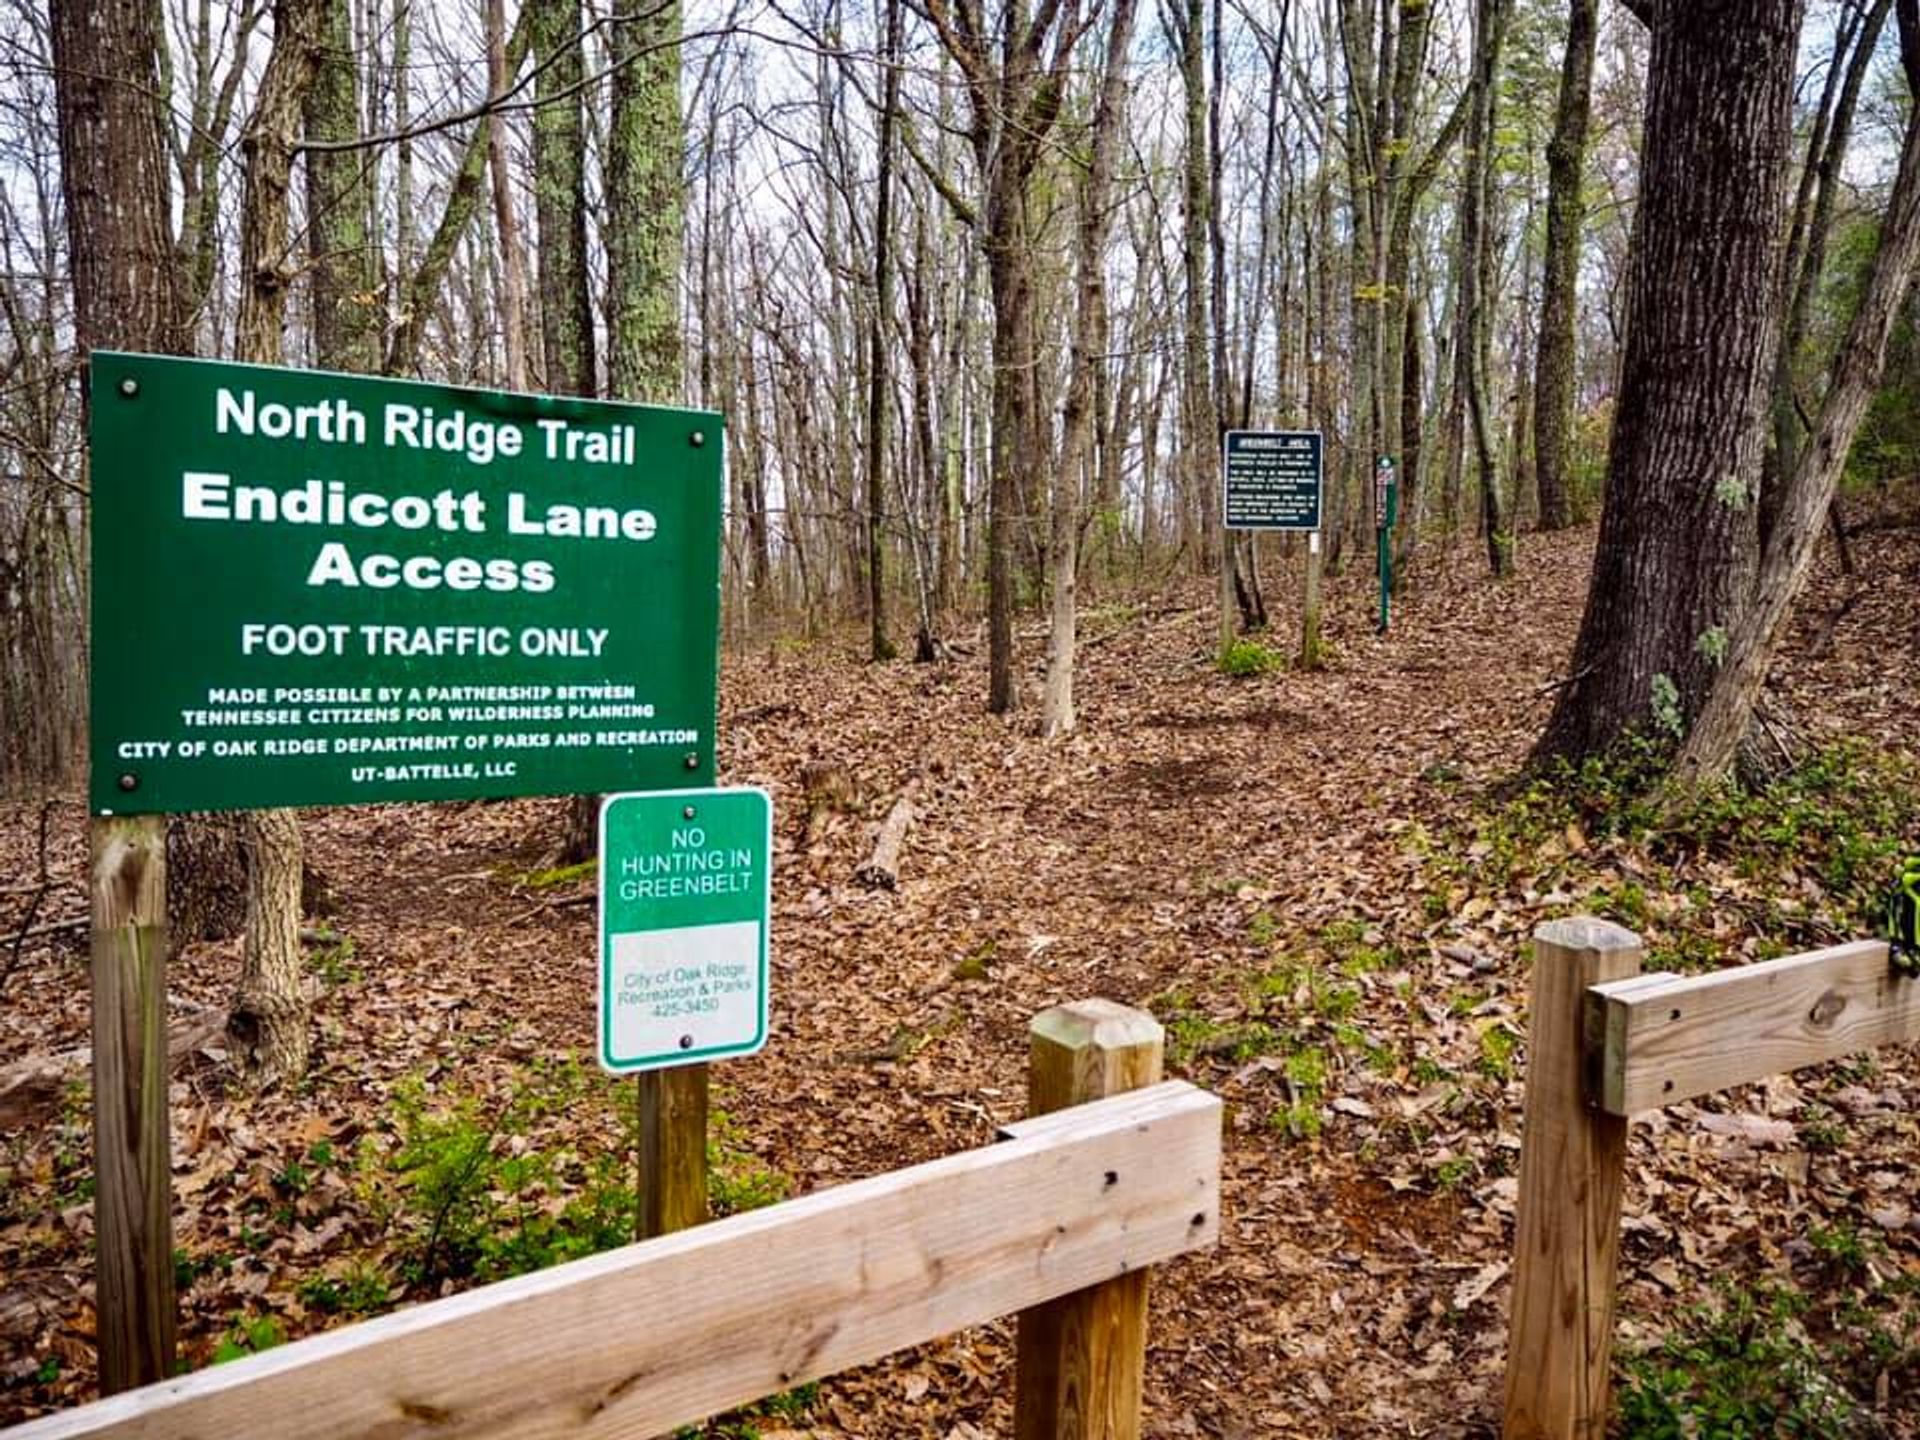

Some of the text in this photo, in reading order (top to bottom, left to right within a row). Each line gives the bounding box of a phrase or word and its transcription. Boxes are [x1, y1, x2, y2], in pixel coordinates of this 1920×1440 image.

[217, 389, 634, 464] North Ridge Trail
[184, 473, 656, 539] Endicott Lane
[308, 543, 554, 591] Access
[243, 625, 608, 656] FOOT TRAFFIC ONLY
[209, 686, 634, 703] MADE POSSIBLE BY A PARTNERSHIP BETWEEN
[182, 705, 654, 725] TENNESSEE CITIZENS FOR WILDERNESS PLANNING
[119, 730, 697, 758] CITY OF OAK RIDGE DEPARTMENT OF PARKS AND RECREATION
[352, 762, 515, 781] UT-BATTELLE, LLC
[672, 828, 704, 848] NO
[622, 849, 752, 876] HUNTING IN
[619, 871, 753, 900] GREENBELT
[624, 962, 745, 990] City of Oak Ridge
[618, 978, 751, 1007] Recreation & Parks
